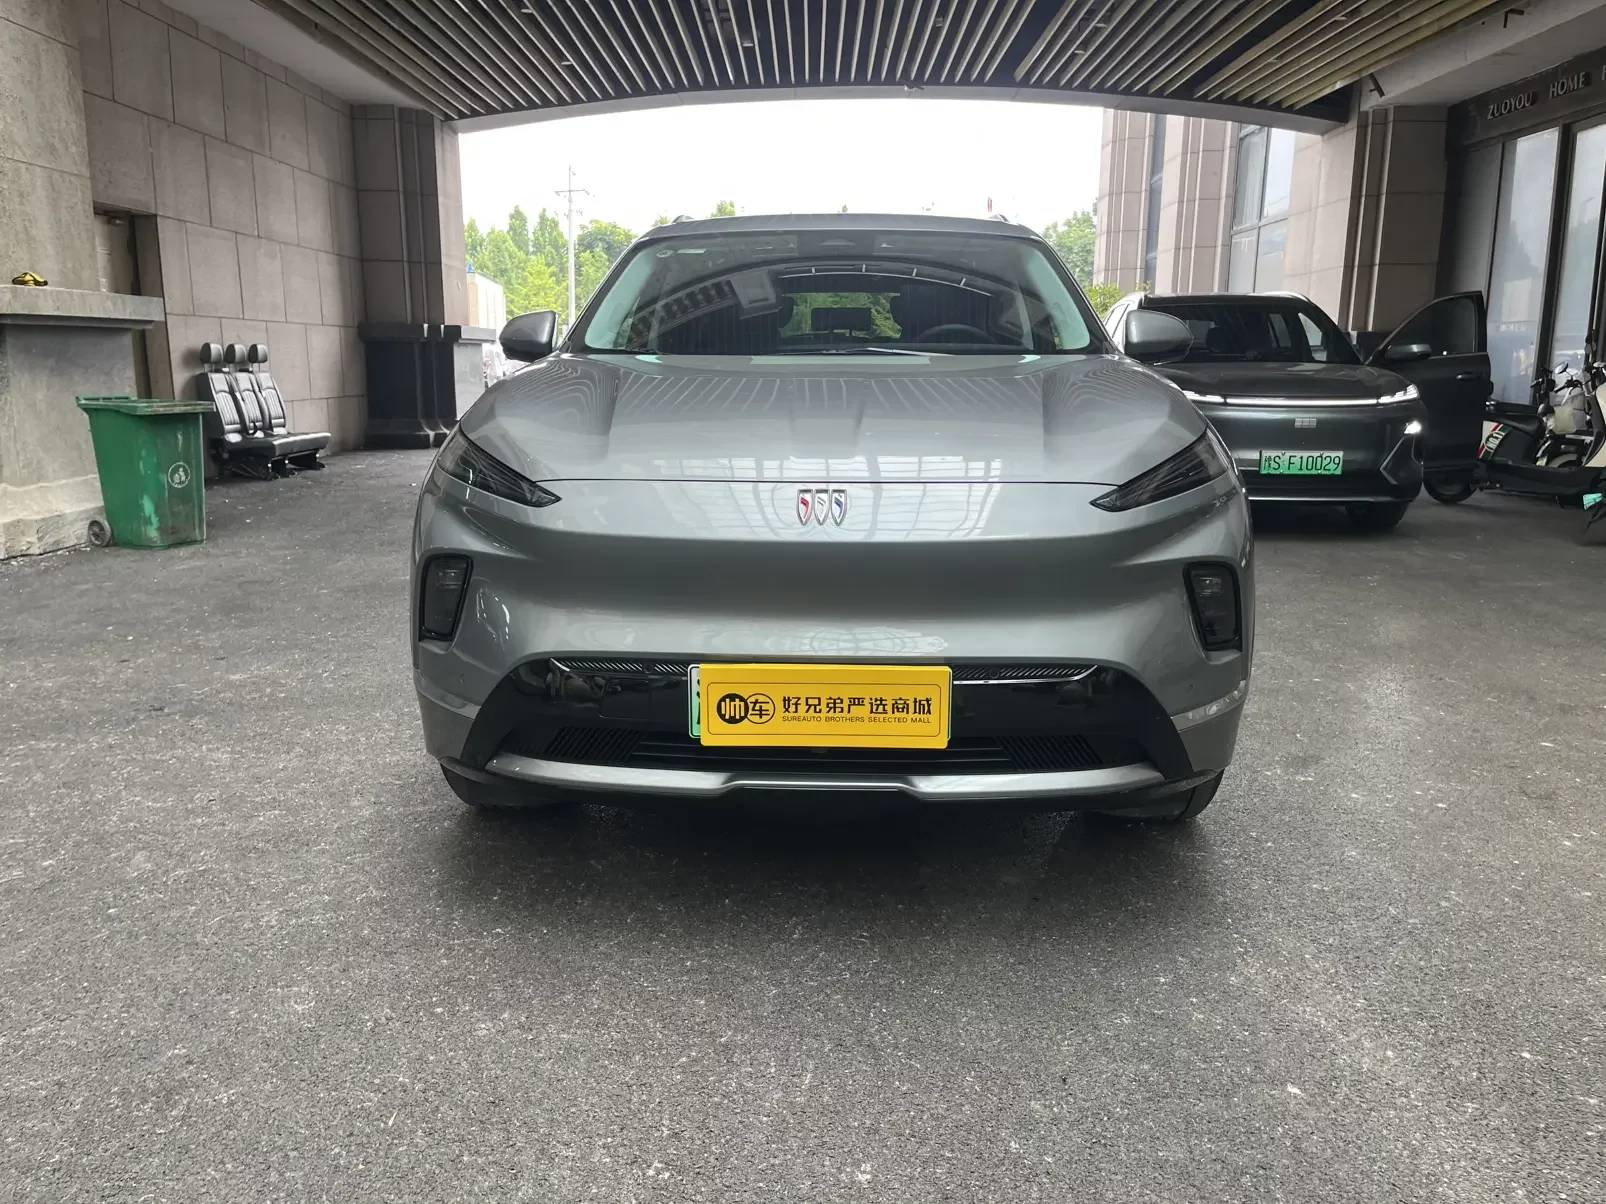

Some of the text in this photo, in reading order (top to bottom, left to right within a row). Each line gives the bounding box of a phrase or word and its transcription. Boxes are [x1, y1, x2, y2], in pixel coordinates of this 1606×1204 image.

[1487, 92, 1533, 120] ZUOYOU
[1549, 71, 1586, 98] HOME
[782, 696, 932, 715] 好兄弟严选商城
[782, 715, 822, 723] SUREAUTO
[868, 716, 908, 724] SELECTED
